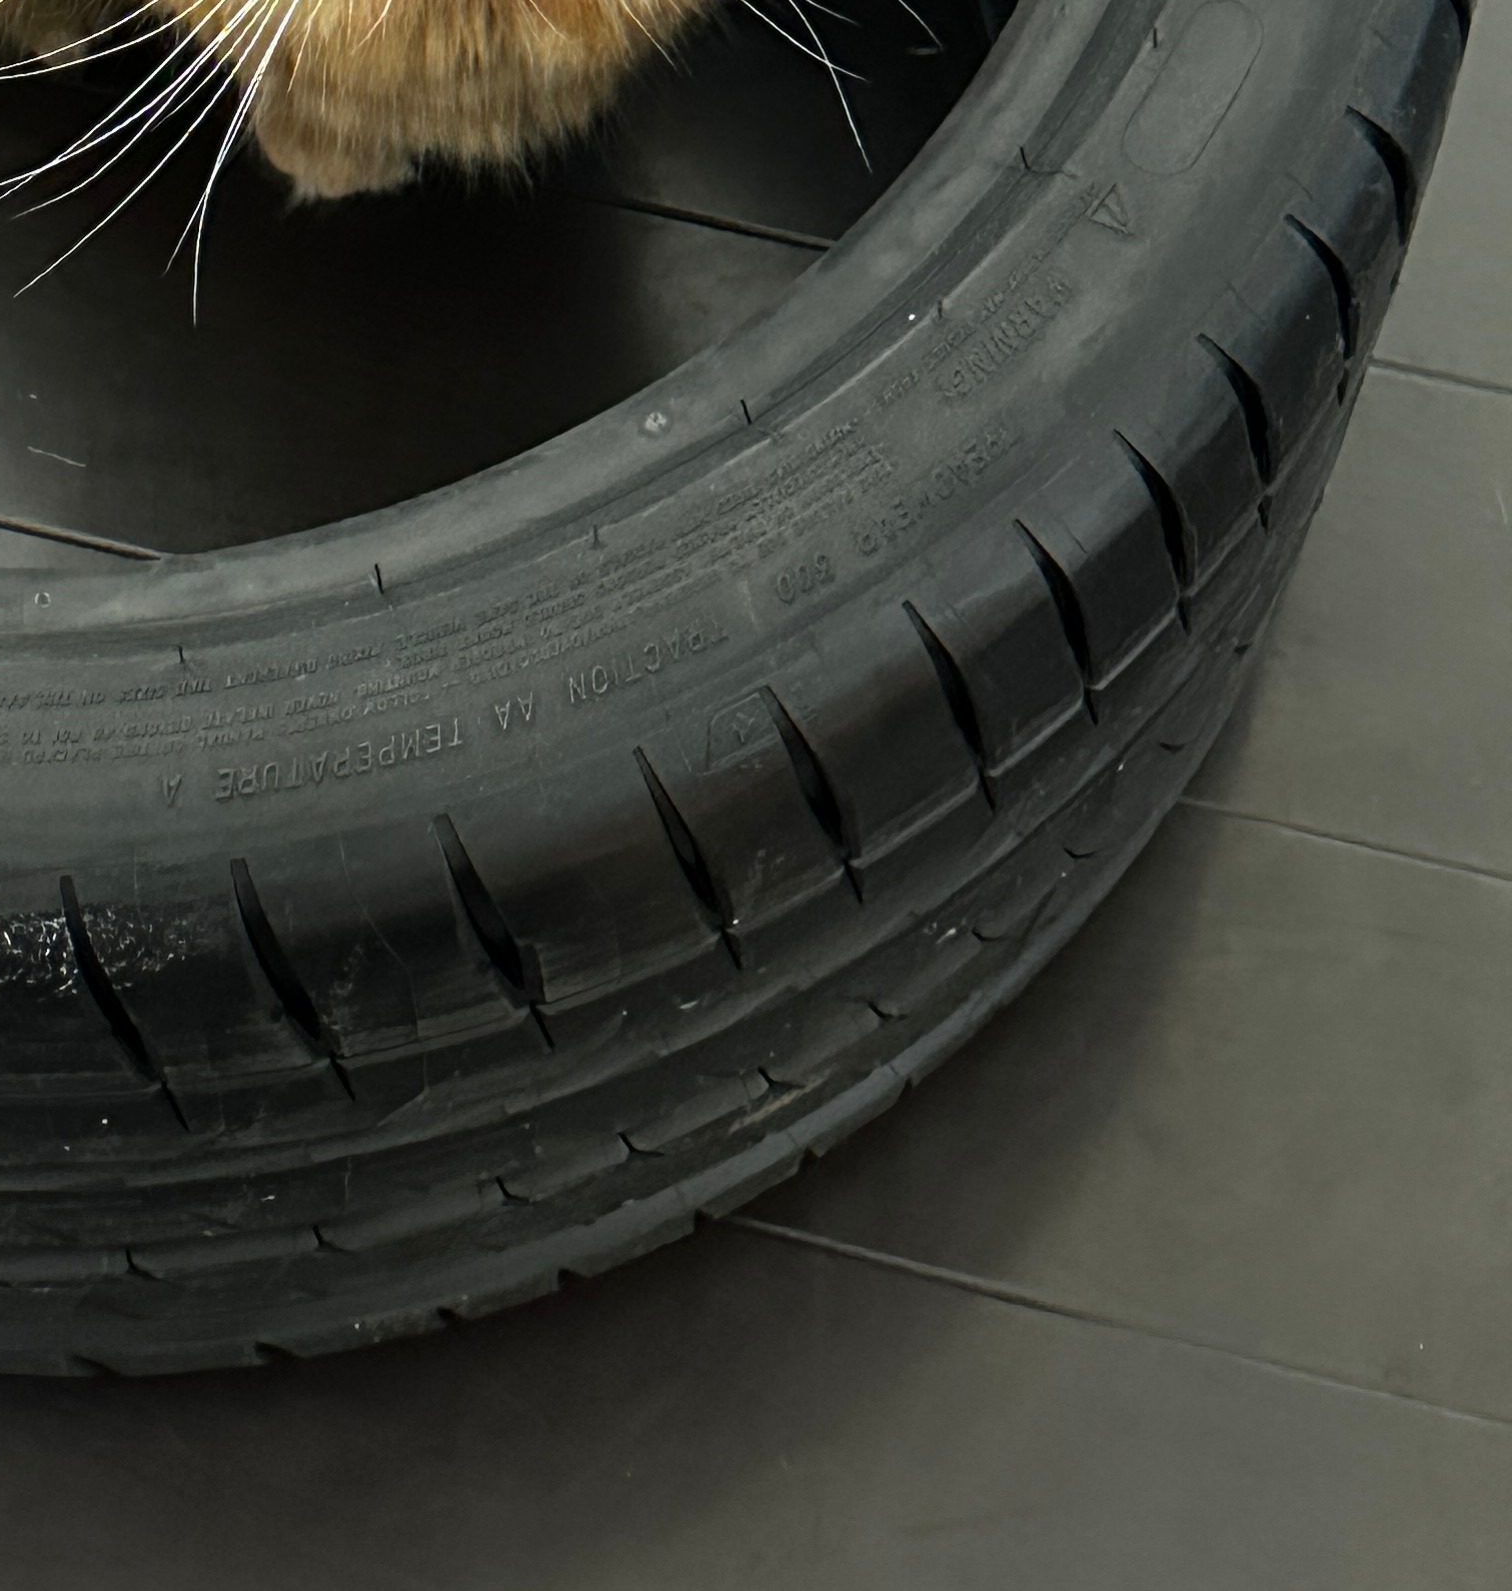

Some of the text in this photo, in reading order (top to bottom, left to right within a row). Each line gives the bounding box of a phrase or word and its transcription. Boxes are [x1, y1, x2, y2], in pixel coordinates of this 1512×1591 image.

[559, 609, 730, 705] TRACTION
[489, 688, 537, 731] AA
[157, 772, 183, 807] A
[211, 714, 466, 802] TEMPERATURE
